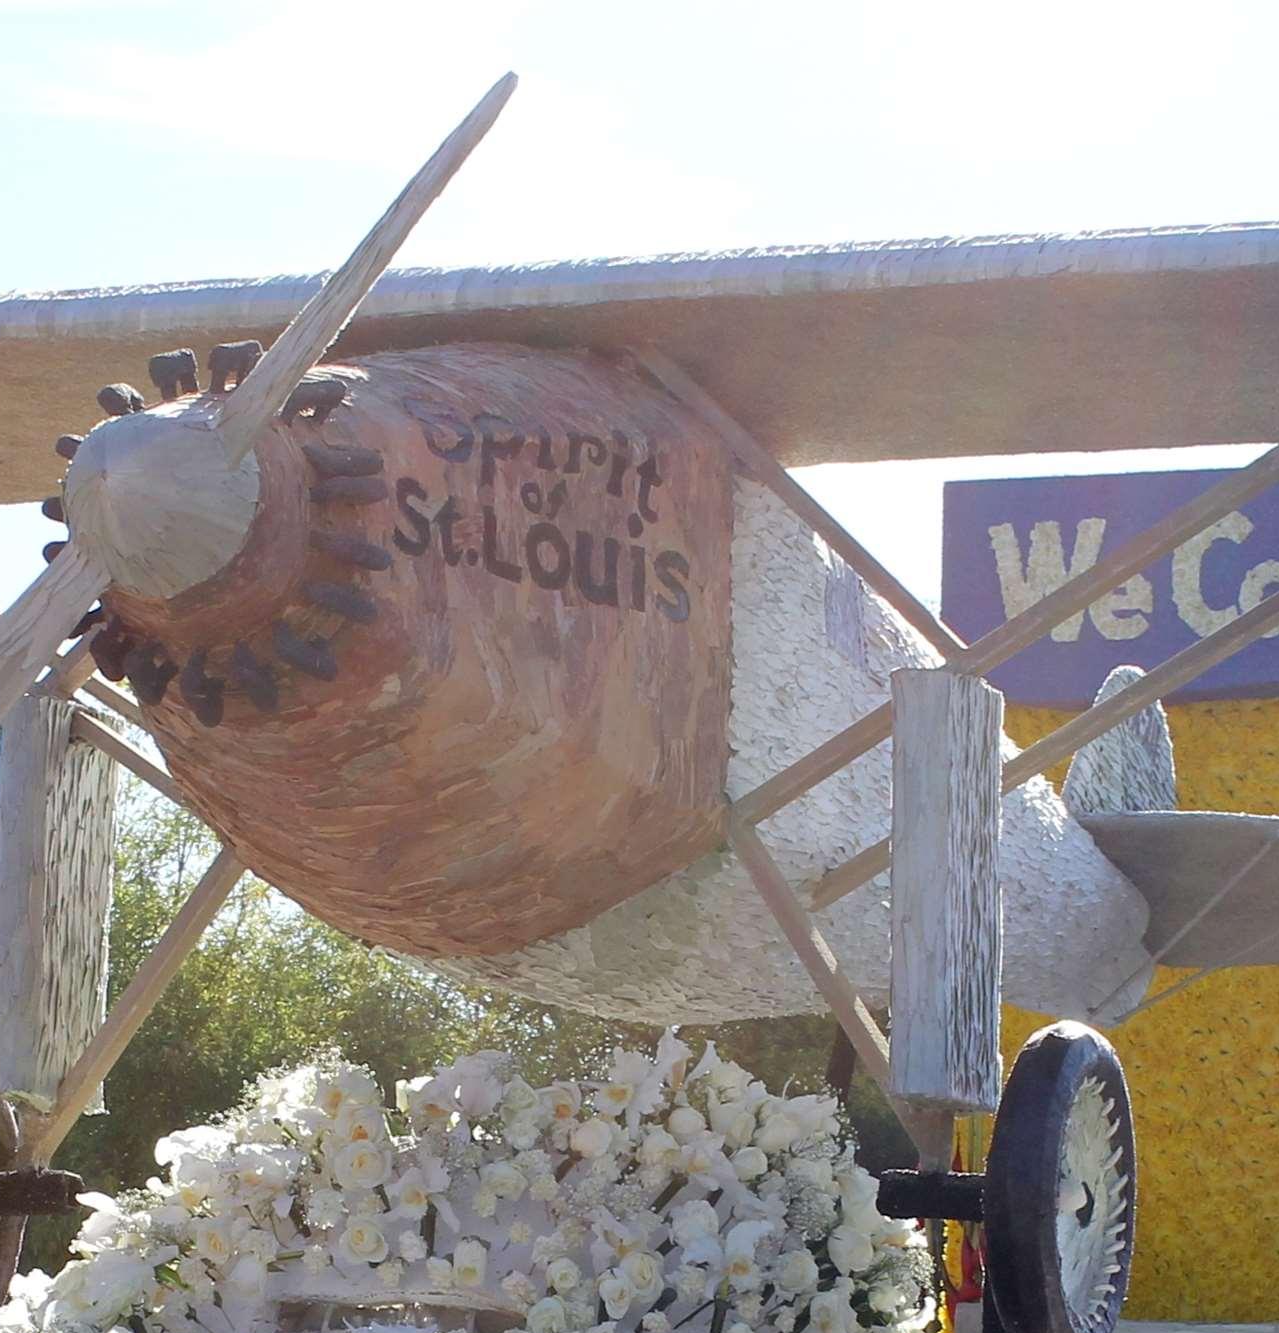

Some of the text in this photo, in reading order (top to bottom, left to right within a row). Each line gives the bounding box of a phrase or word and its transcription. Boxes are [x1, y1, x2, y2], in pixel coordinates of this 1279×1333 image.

[404, 397, 663, 523] Spirit
[521, 479, 568, 520] of
[988, 517, 1154, 643] We
